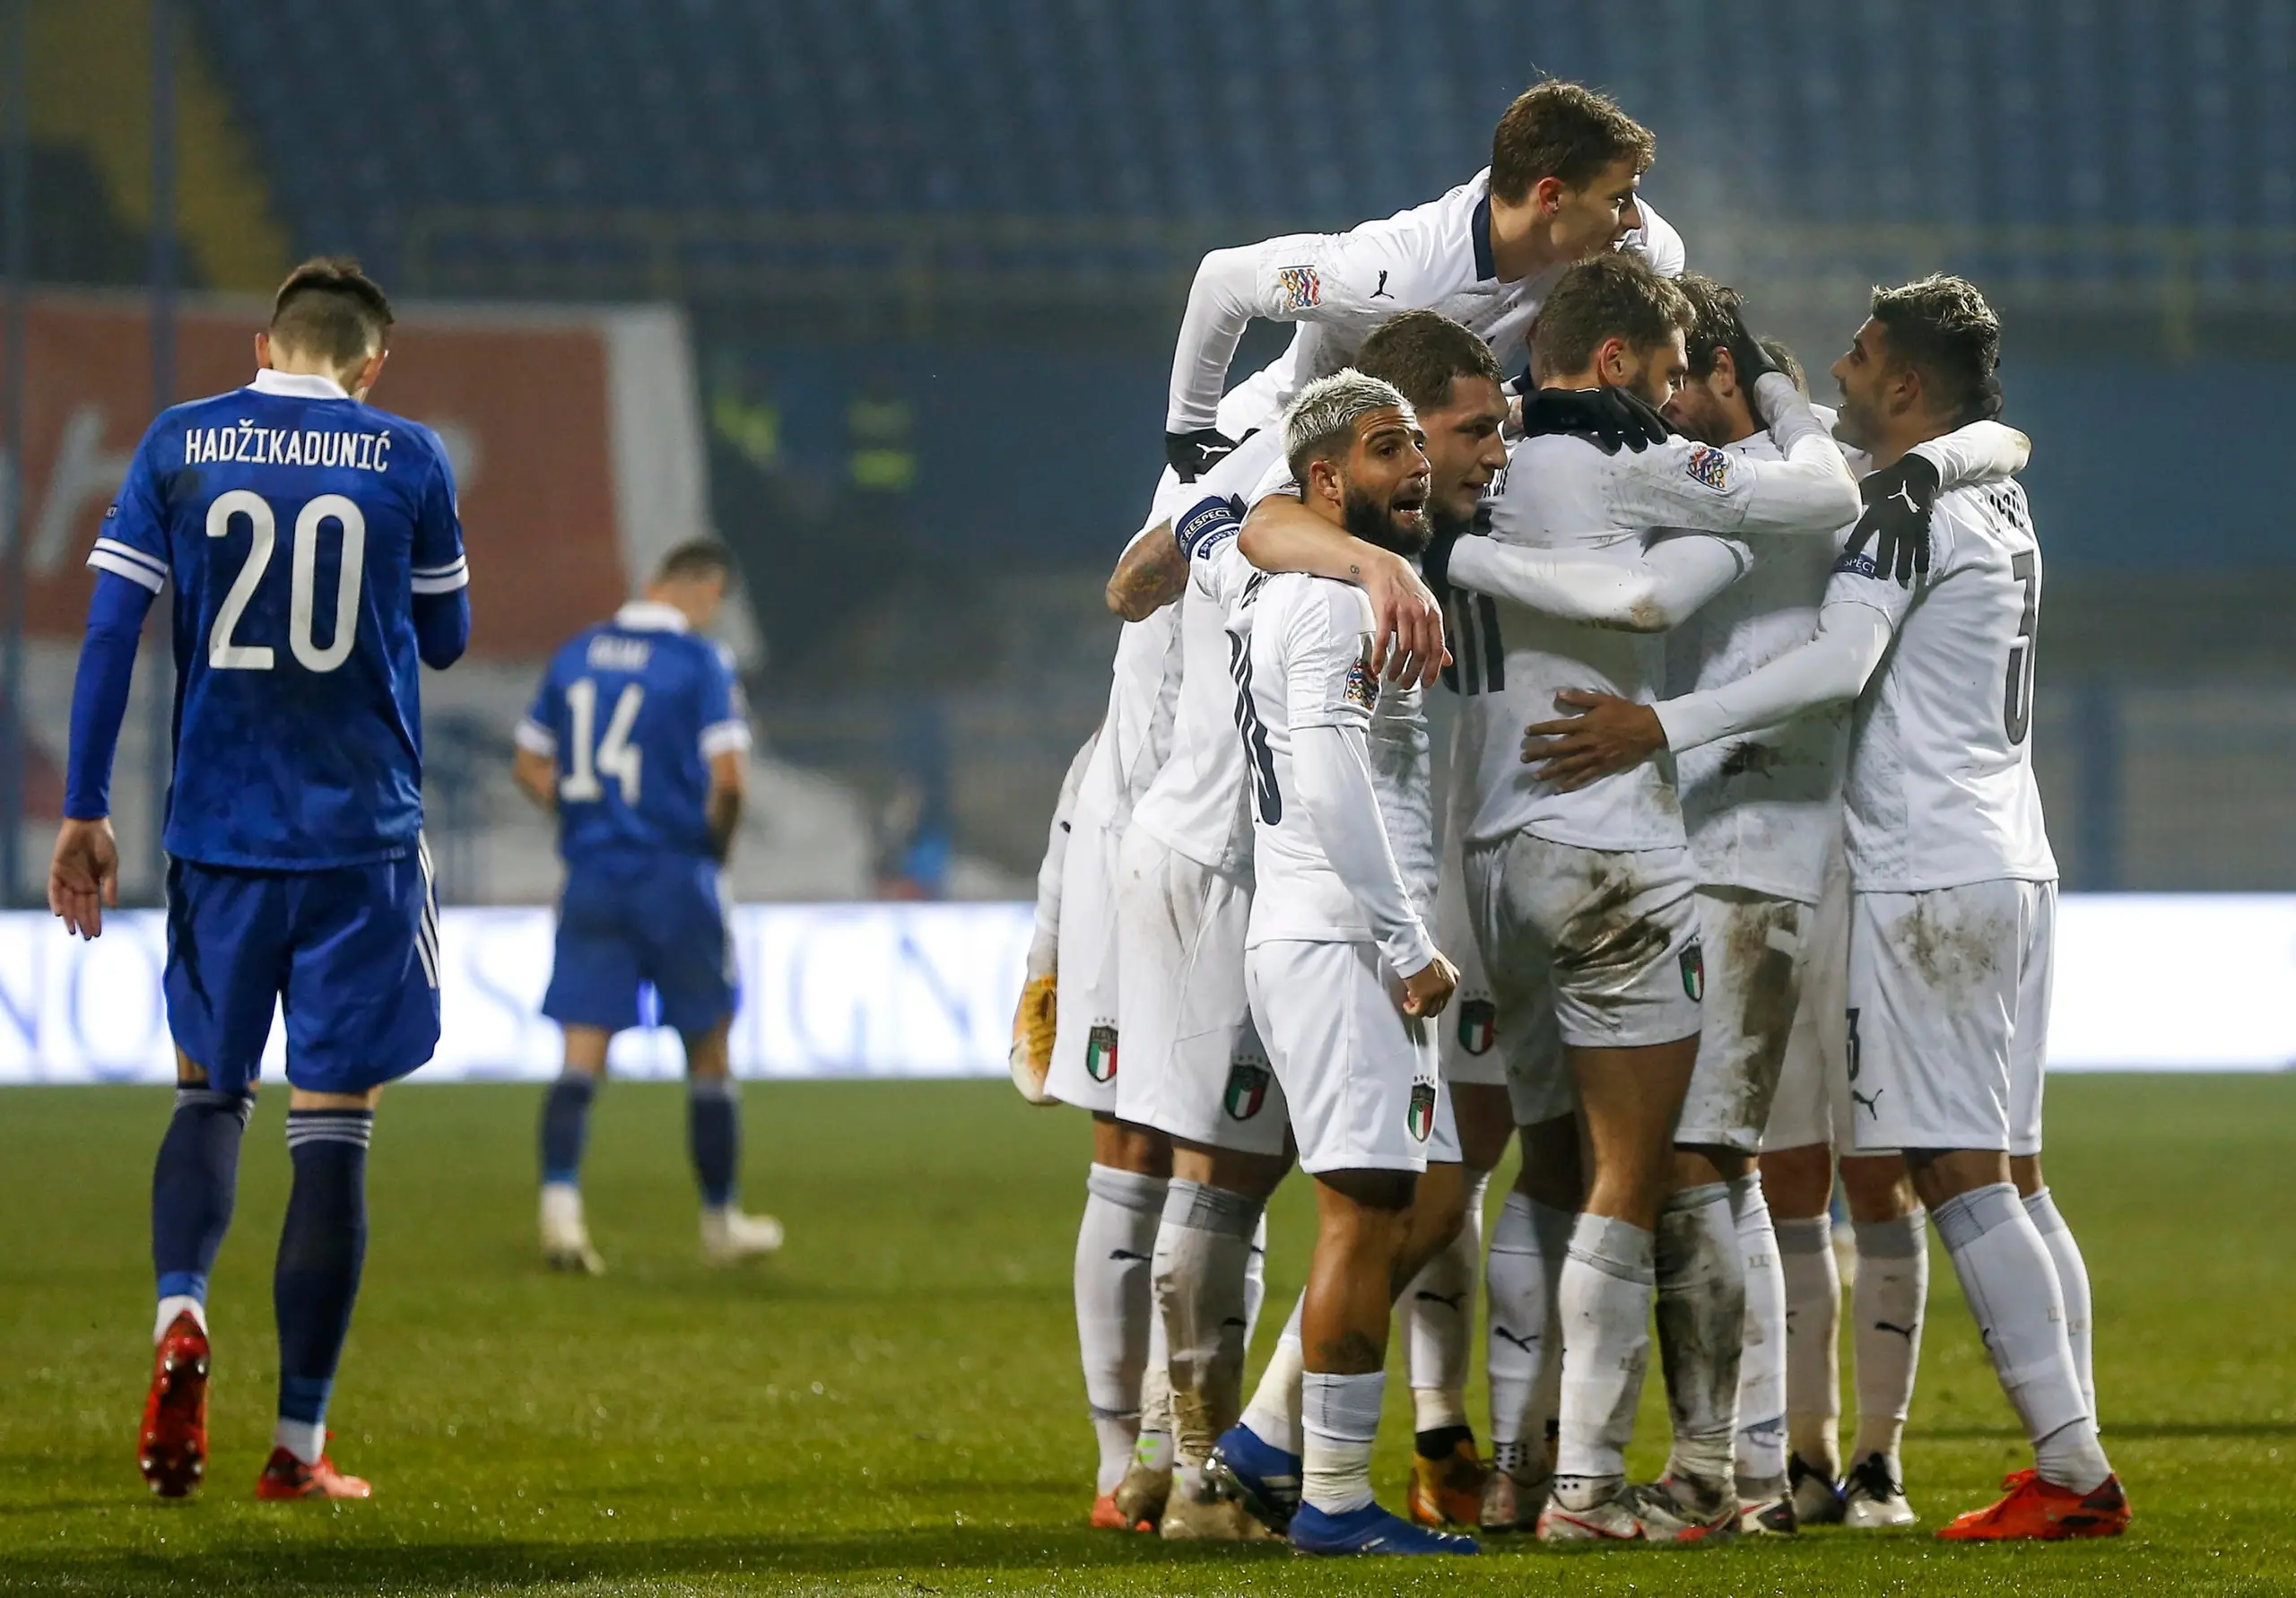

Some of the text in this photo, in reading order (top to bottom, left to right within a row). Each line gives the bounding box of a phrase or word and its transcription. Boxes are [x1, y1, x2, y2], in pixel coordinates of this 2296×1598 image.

[186, 419, 391, 472] HADŽIKADUNIĆ
[1186, 509, 1232, 538] RESPECT
[1842, 558, 1876, 574] SPECT
[206, 490, 364, 671] 20
[2004, 549, 2037, 746] 3
[561, 679, 643, 803] 14
